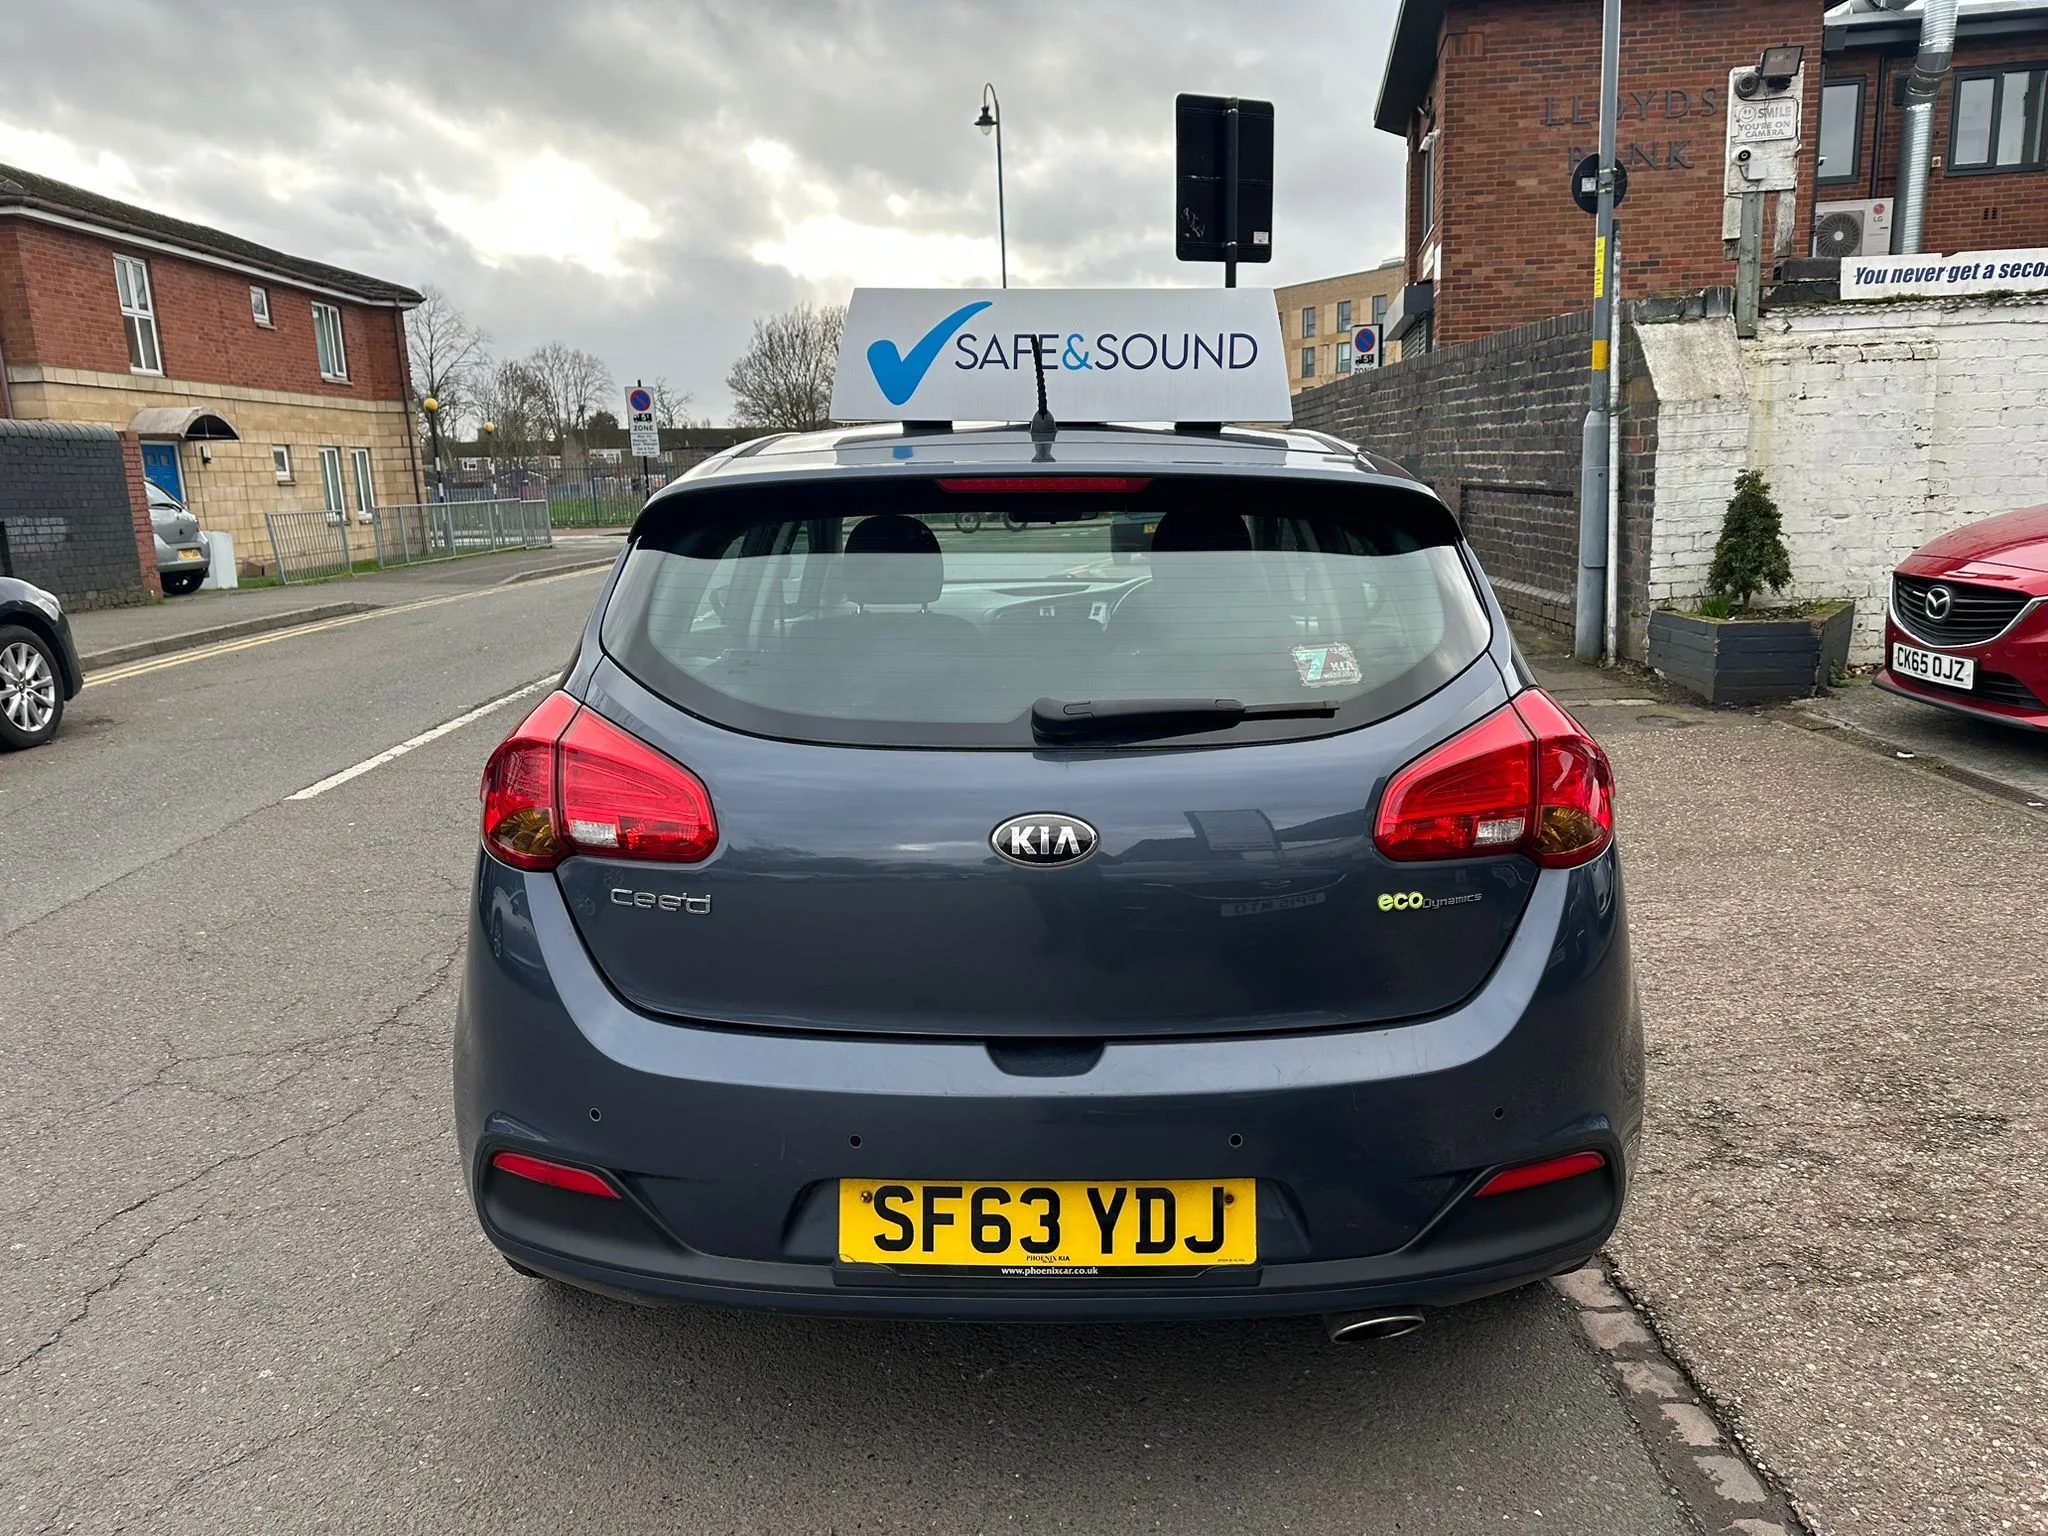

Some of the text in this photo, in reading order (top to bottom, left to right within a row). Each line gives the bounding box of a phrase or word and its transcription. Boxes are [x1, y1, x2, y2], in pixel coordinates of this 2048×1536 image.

[1758, 106, 1791, 119] SMILE
[1745, 129, 1785, 138] CAMERA
[1775, 120, 1790, 128] ON
[1568, 139, 1694, 175] BNK
[1855, 267, 1887, 285] You
[1890, 266, 1946, 284] never
[1946, 263, 1980, 283] get
[1982, 263, 1995, 279] a
[1897, 646, 1928, 675] CK65
[1932, 656, 1966, 682] OJZ
[1010, 826, 1081, 855] KIA
[873, 1185, 1225, 1255] SF63 YDJ
[1001, 1267, 1099, 1276] www.phoenixcar.co.uk
